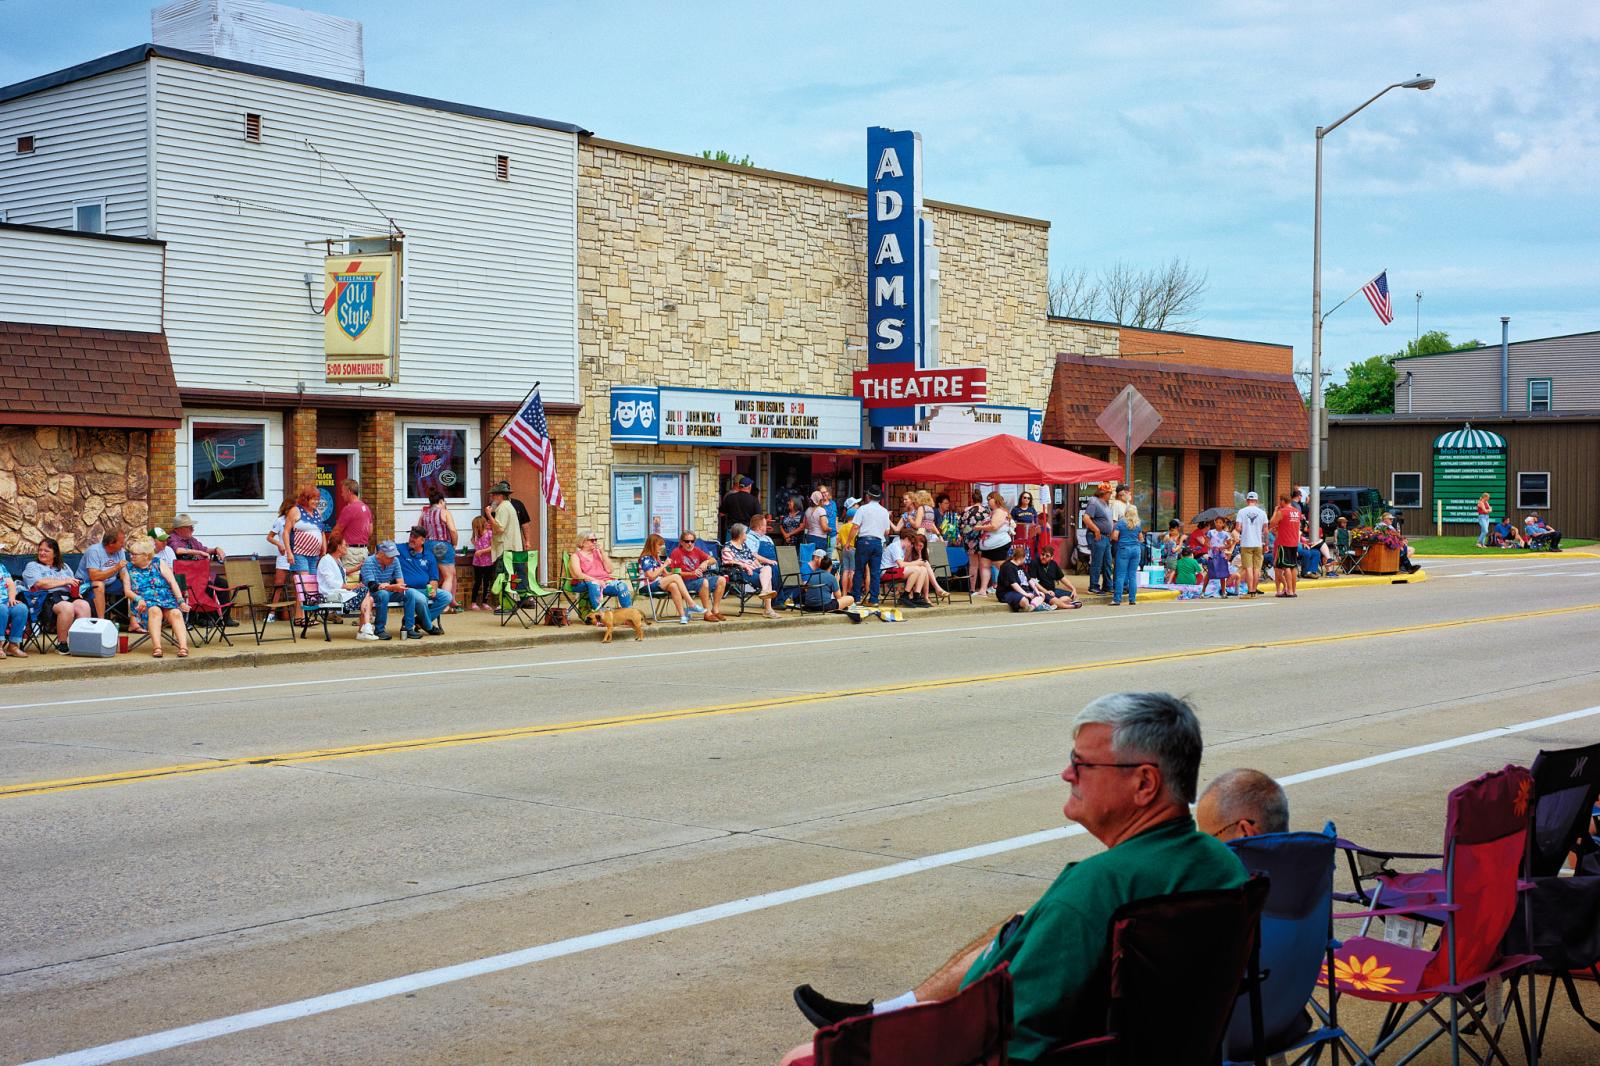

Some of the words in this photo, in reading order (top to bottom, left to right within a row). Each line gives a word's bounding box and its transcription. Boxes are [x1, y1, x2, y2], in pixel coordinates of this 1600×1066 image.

[874, 147, 905, 351] ADAMS
[346, 283, 367, 304] Old
[340, 302, 370, 333] Style
[327, 363, 341, 375] 5:00
[342, 363, 384, 375] SOMEWHERE
[859, 375, 964, 400] THEATRE
[735, 400, 755, 412] MOVIES
[756, 401, 785, 413] THURSDAYS
[665, 410, 676, 422] JUL
[677, 411, 682, 422] 11
[685, 411, 700, 423] JOHN
[701, 411, 715, 423] WICK
[716, 412, 721, 423] 4
[738, 413, 748, 424] JUL
[749, 414, 757, 425] 25
[758, 414, 775, 426] MAGIC
[790, 415, 802, 427] LAST
[803, 416, 819, 427] DANCE
[665, 424, 676, 436] JUL
[677, 425, 684, 436] 18
[686, 425, 722, 437] OPPENHEIMER
[762, 428, 769, 438] 27
